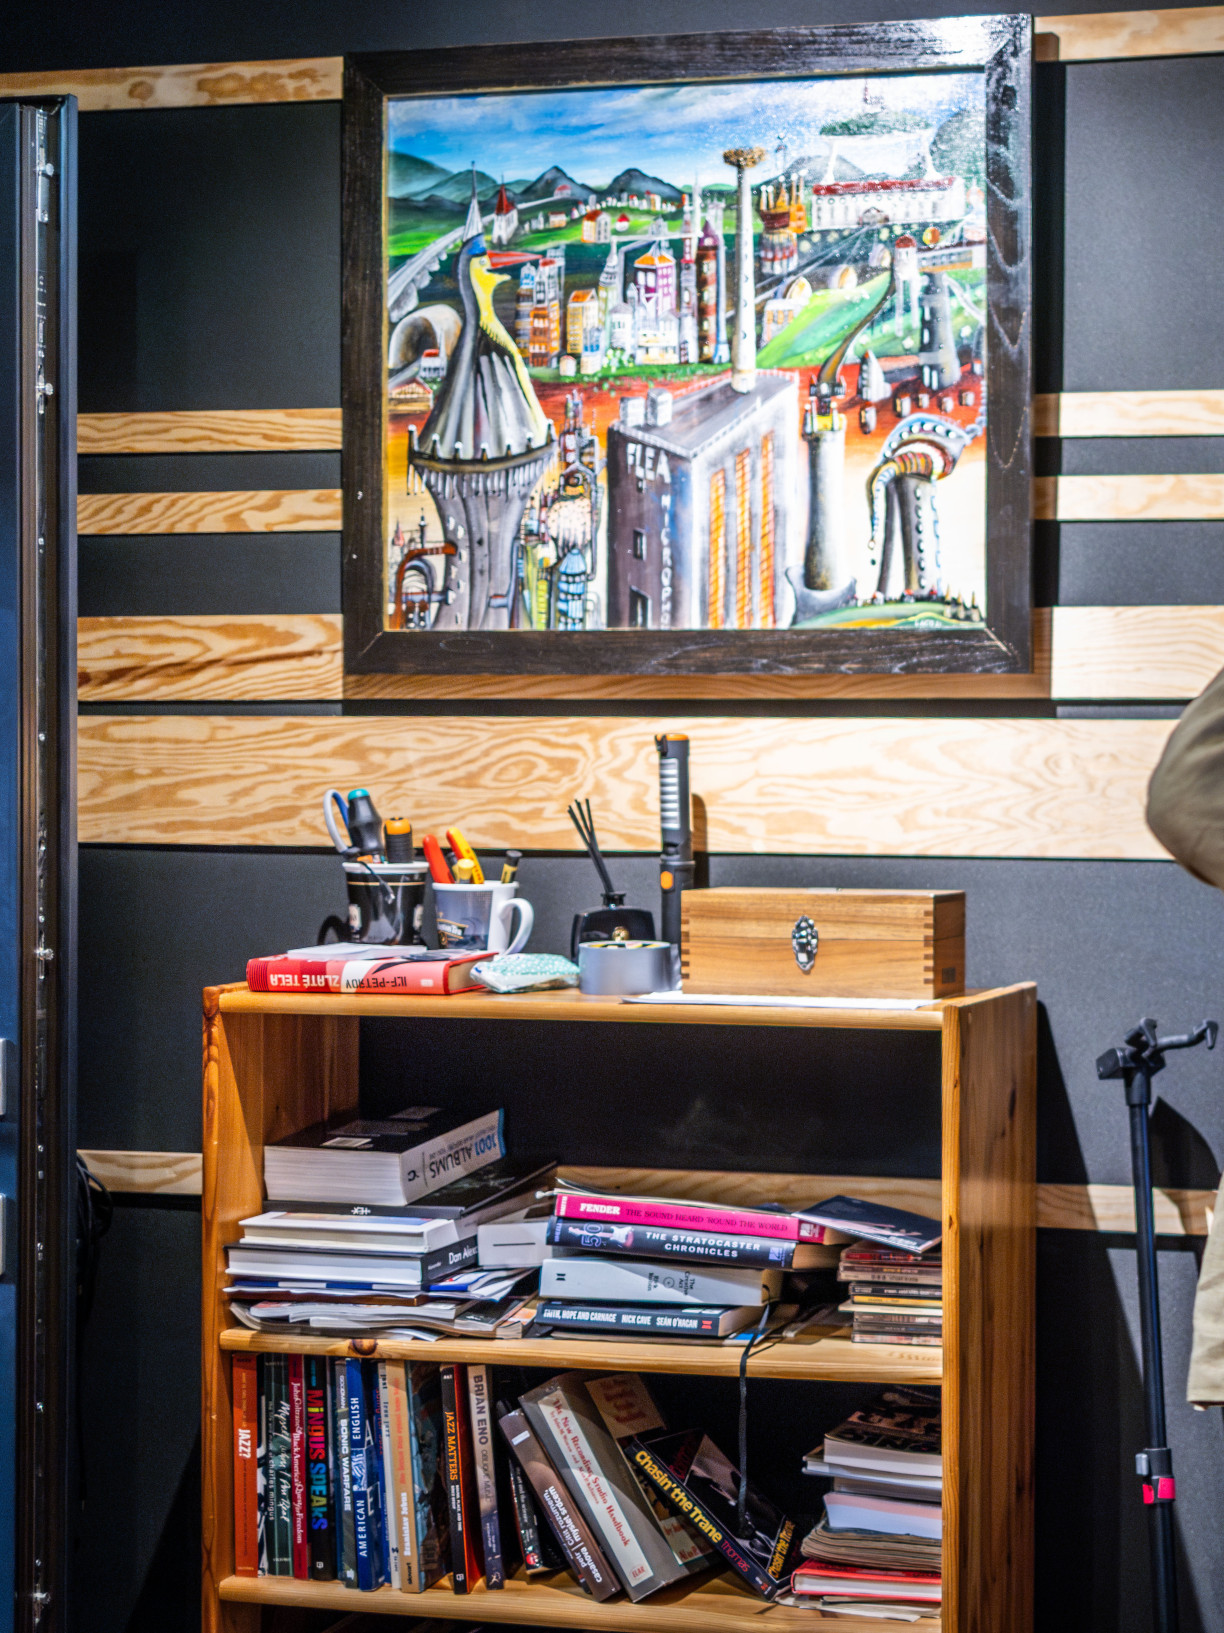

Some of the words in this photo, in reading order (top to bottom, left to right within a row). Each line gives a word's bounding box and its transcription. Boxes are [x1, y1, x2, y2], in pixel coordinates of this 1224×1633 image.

[626, 442, 672, 484] FLEA
[429, 1142, 475, 1179] ALBUMS
[474, 1133, 498, 1157] 1001
[579, 1202, 621, 1216] FENDER
[625, 1208, 643, 1218] THE
[644, 1211, 674, 1220] SOUND
[675, 1214, 704, 1223] HEARD
[738, 1219, 756, 1229] THE
[757, 1221, 788, 1232] WORLD
[645, 1231, 667, 1241] THE
[672, 1234, 761, 1251] STRATOCASTER
[664, 1242, 739, 1258] CHRONICLES
[561, 1309, 577, 1320] HOPE
[576, 1311, 591, 1321] AND
[590, 1312, 618, 1323] CARNAGE
[621, 1314, 637, 1324] NICK
[636, 1315, 652, 1326] CAVE
[473, 1374, 487, 1415] BRIAN
[350, 1397, 361, 1440] ENGLISH
[445, 1411, 456, 1434] JAZZ
[477, 1418, 489, 1446] ENO
[238, 1427, 252, 1459] JAZZ?
[340, 1419, 350, 1455] SONIC
[268, 1459, 276, 1489] charles
[448, 1436, 458, 1481] MATTERS
[342, 1456, 352, 1512] WARFARE
[561, 1416, 573, 1435] New
[570, 1436, 594, 1478] Recording
[592, 1476, 608, 1504] Studio
[606, 1505, 631, 1547] Handbook
[635, 1449, 677, 1491] Chasin'
[669, 1485, 693, 1512] the
[689, 1505, 723, 1544] Trane
[267, 1491, 276, 1521] mingus
[548, 1485, 568, 1516] srdcem
[356, 1499, 368, 1558] AMERICAN
[566, 1513, 582, 1542] myslet
[574, 1551, 588, 1568] petr
[579, 1546, 603, 1583] casanova
